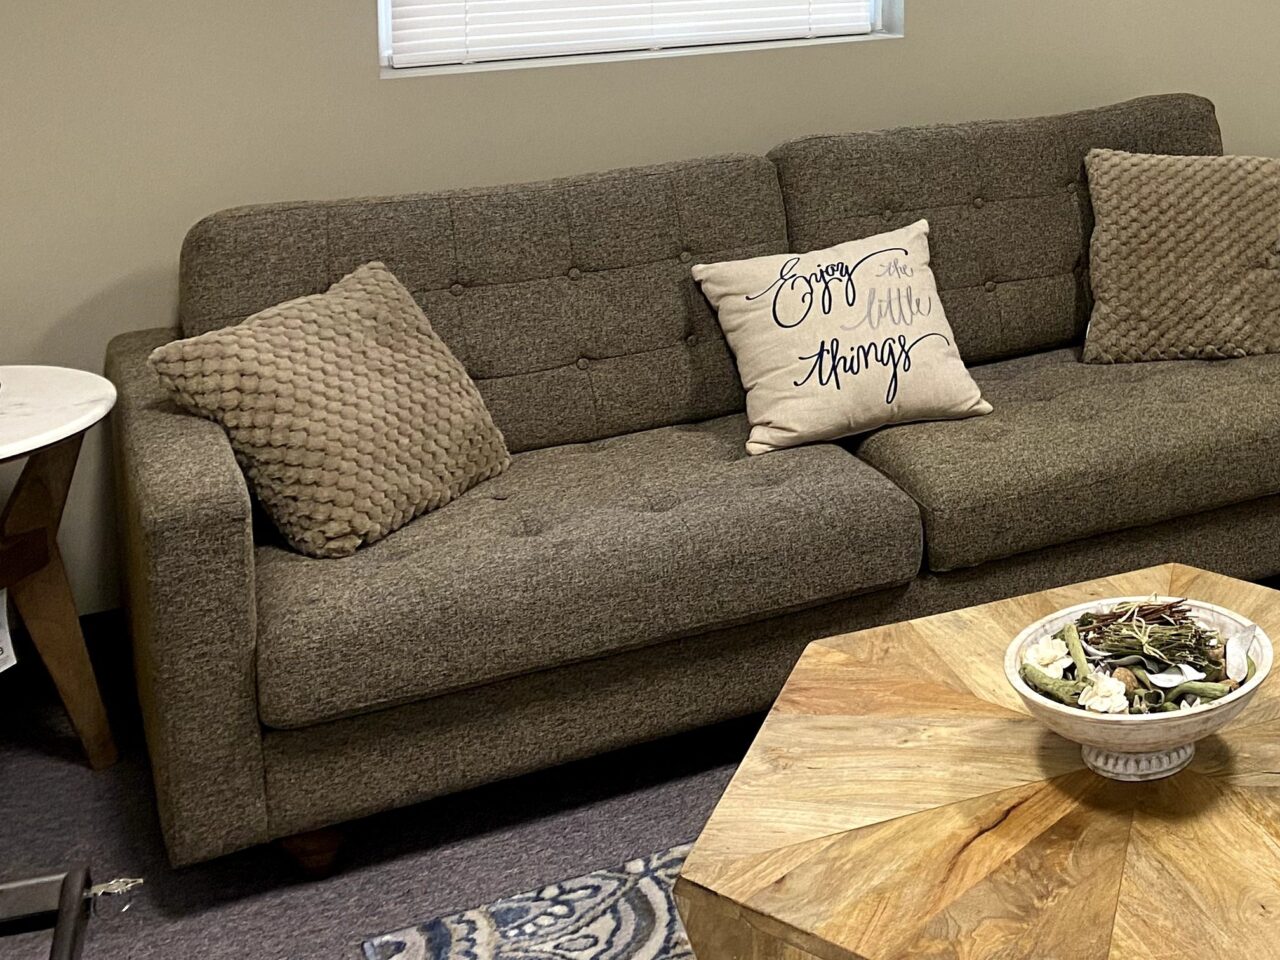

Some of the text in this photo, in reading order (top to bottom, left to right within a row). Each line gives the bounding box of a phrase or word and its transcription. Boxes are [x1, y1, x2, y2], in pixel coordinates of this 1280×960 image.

[745, 247, 915, 329] Enjoy the
[839, 286, 932, 331] little
[793, 333, 951, 405] things
